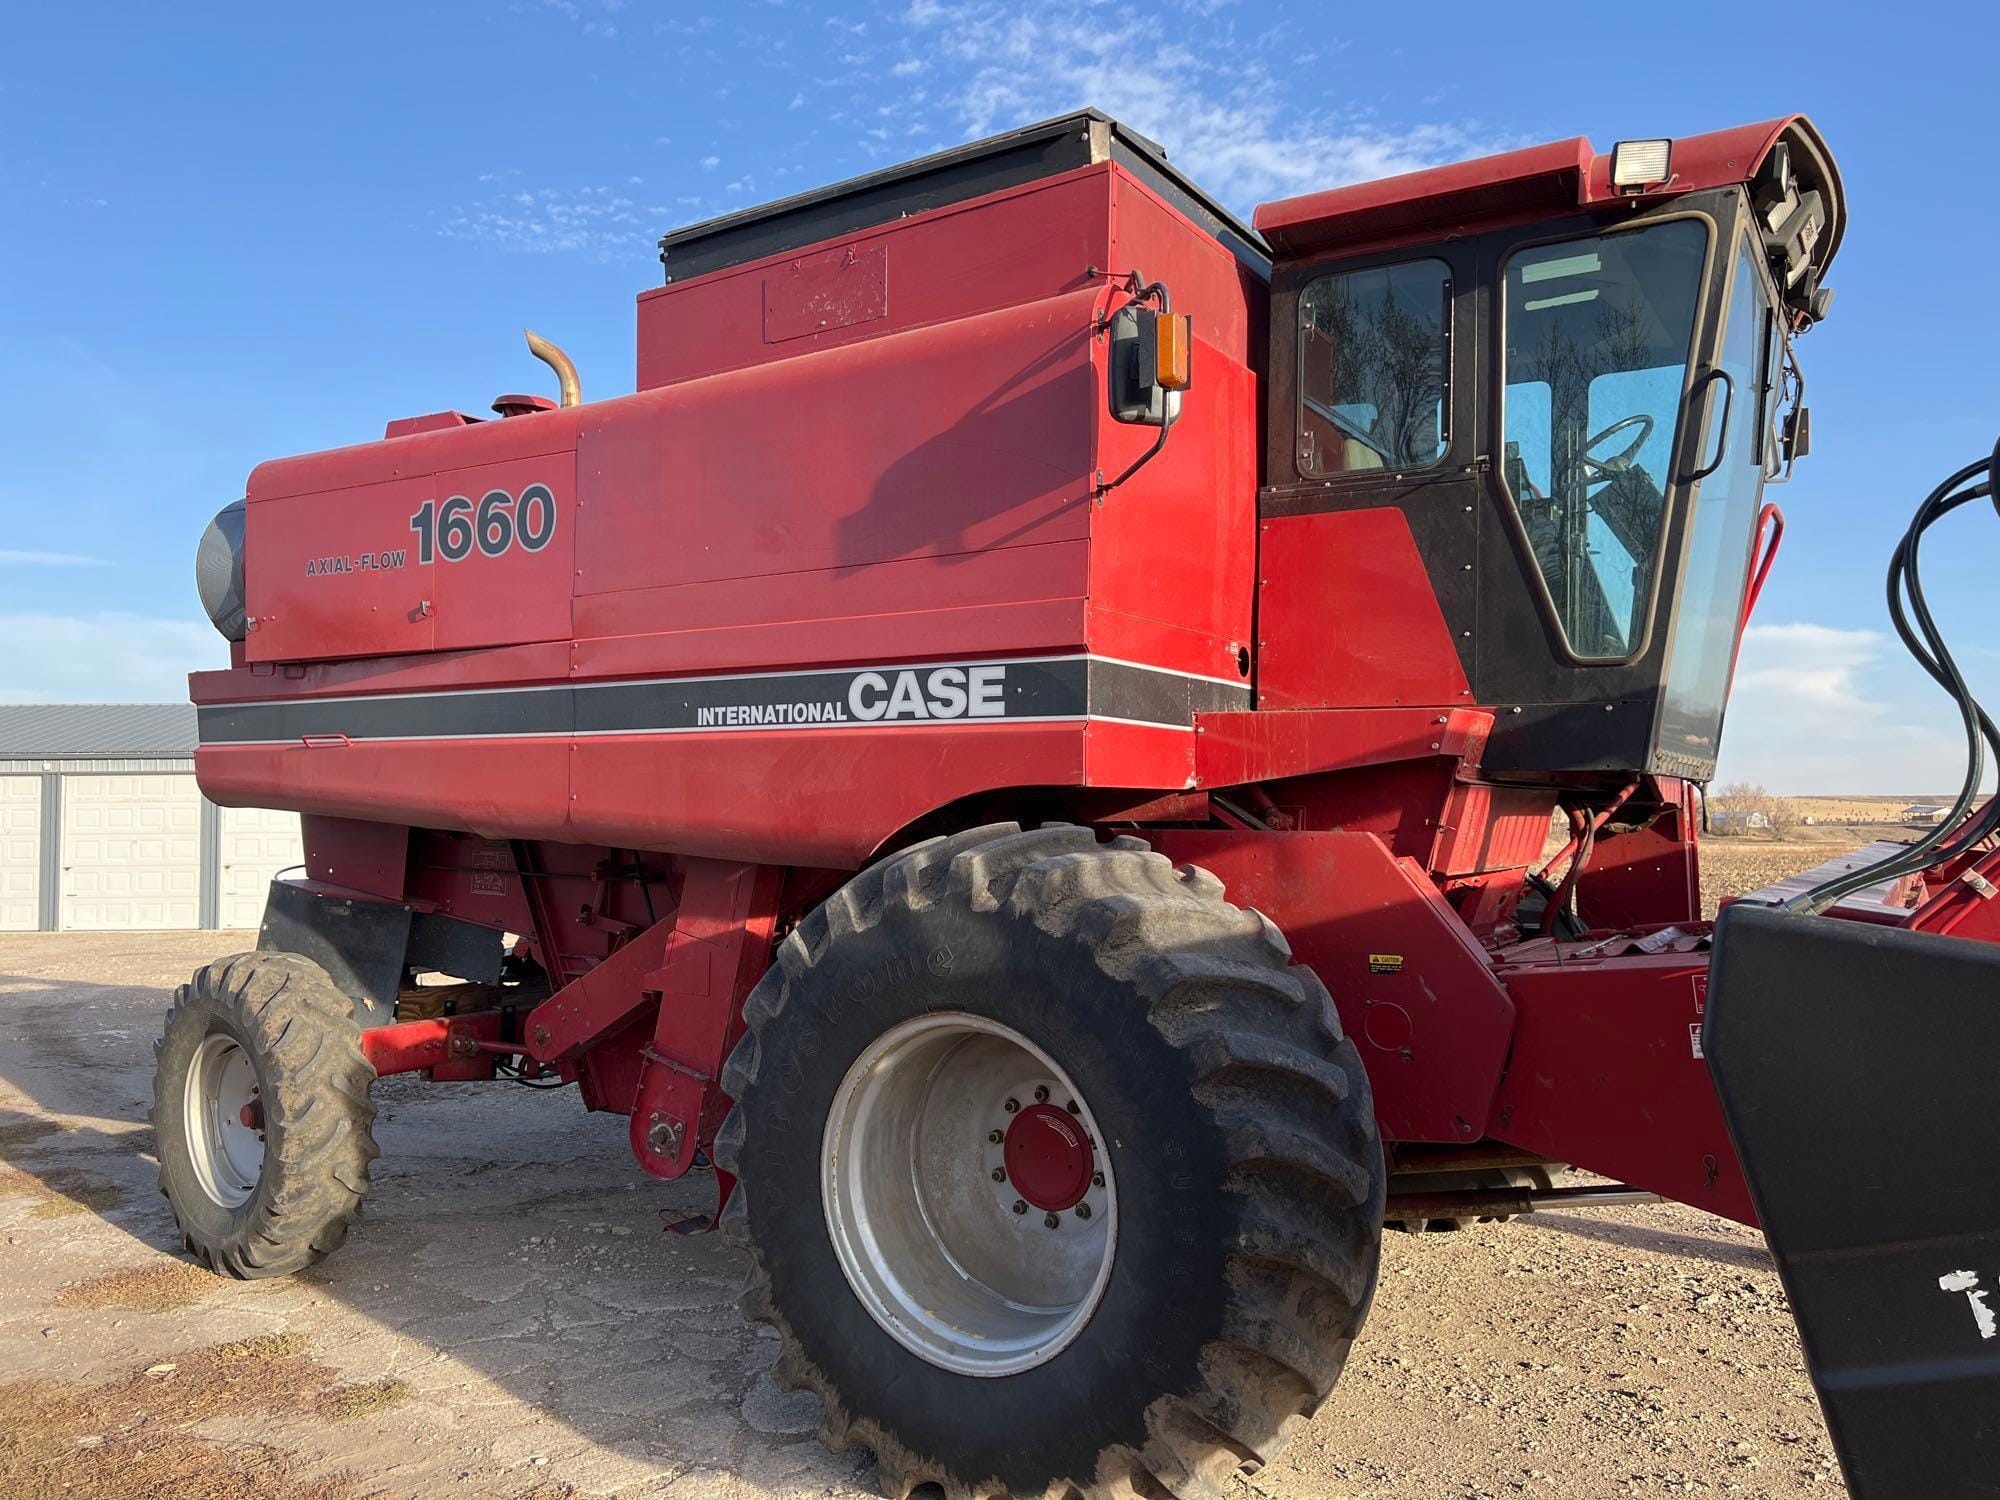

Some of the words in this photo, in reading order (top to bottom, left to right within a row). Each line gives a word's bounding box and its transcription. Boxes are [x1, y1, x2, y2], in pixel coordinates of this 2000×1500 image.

[306, 550, 406, 576] AXIAL-FLOW
[410, 483, 557, 565] 1660
[697, 701, 847, 726] INTERNATIONAL
[848, 666, 1006, 721] CASE
